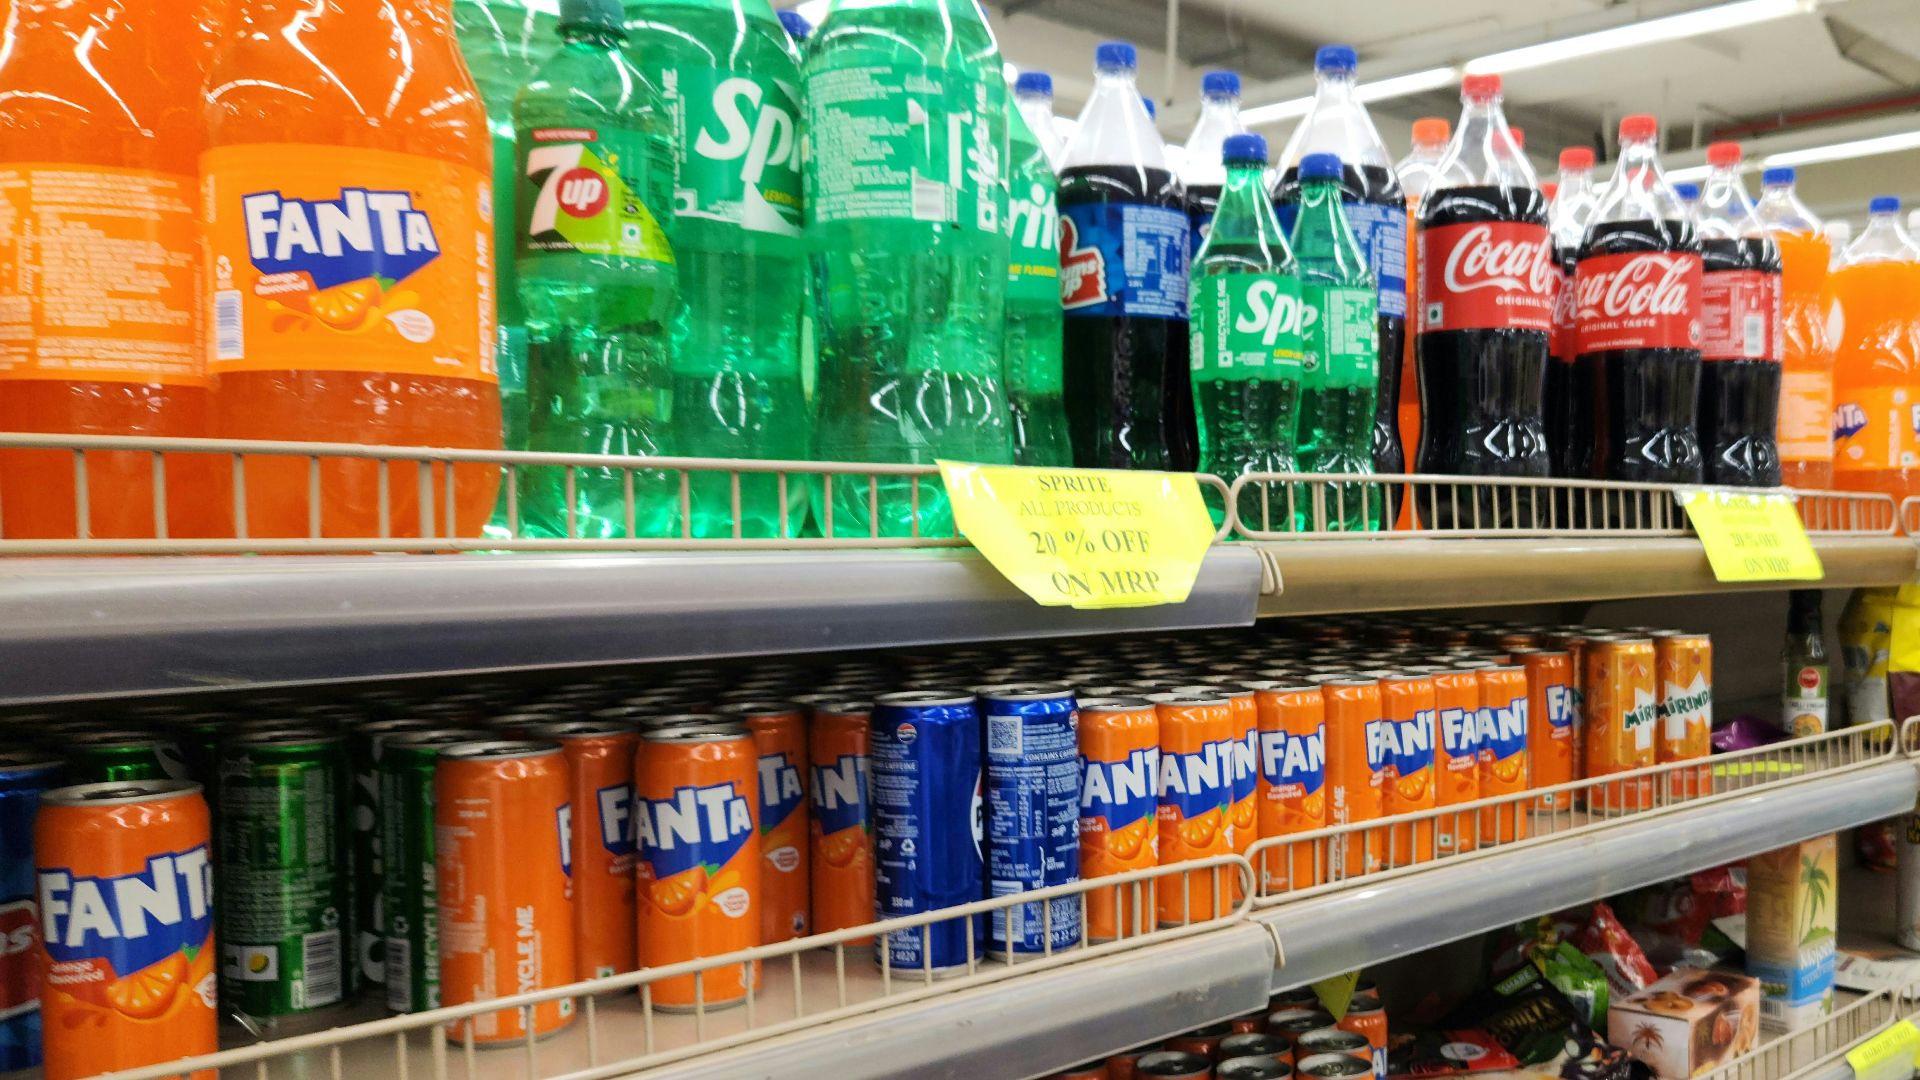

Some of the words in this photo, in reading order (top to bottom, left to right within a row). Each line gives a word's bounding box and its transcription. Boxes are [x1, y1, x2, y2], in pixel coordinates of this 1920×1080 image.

[247, 189, 439, 261] FANTA
[1040, 474, 1112, 493] SPRITE
[1020, 500, 1052, 516] ALL
[1057, 501, 1142, 516] PRODUCTS
[1029, 531, 1057, 555] 20
[1065, 530, 1095, 555] %
[1102, 530, 1150, 554] OFF
[1051, 571, 1092, 596] ON
[1100, 570, 1160, 594] MRP
[517, 905, 534, 937] ME
